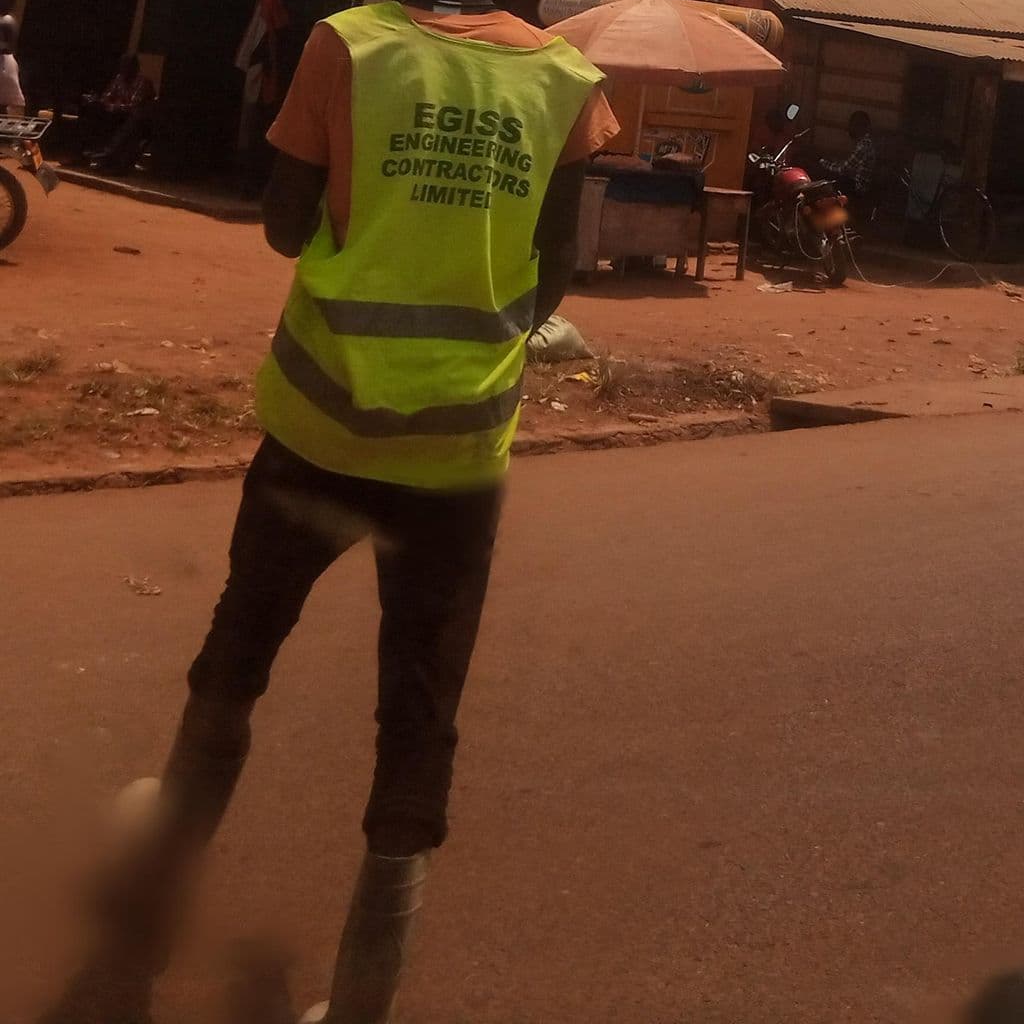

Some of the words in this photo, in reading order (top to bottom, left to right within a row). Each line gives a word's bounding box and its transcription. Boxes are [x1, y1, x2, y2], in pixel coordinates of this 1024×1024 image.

[414, 102, 524, 144] EGISS
[389, 133, 533, 173] ENGINEERING
[381, 158, 531, 198] CONTRACTORS
